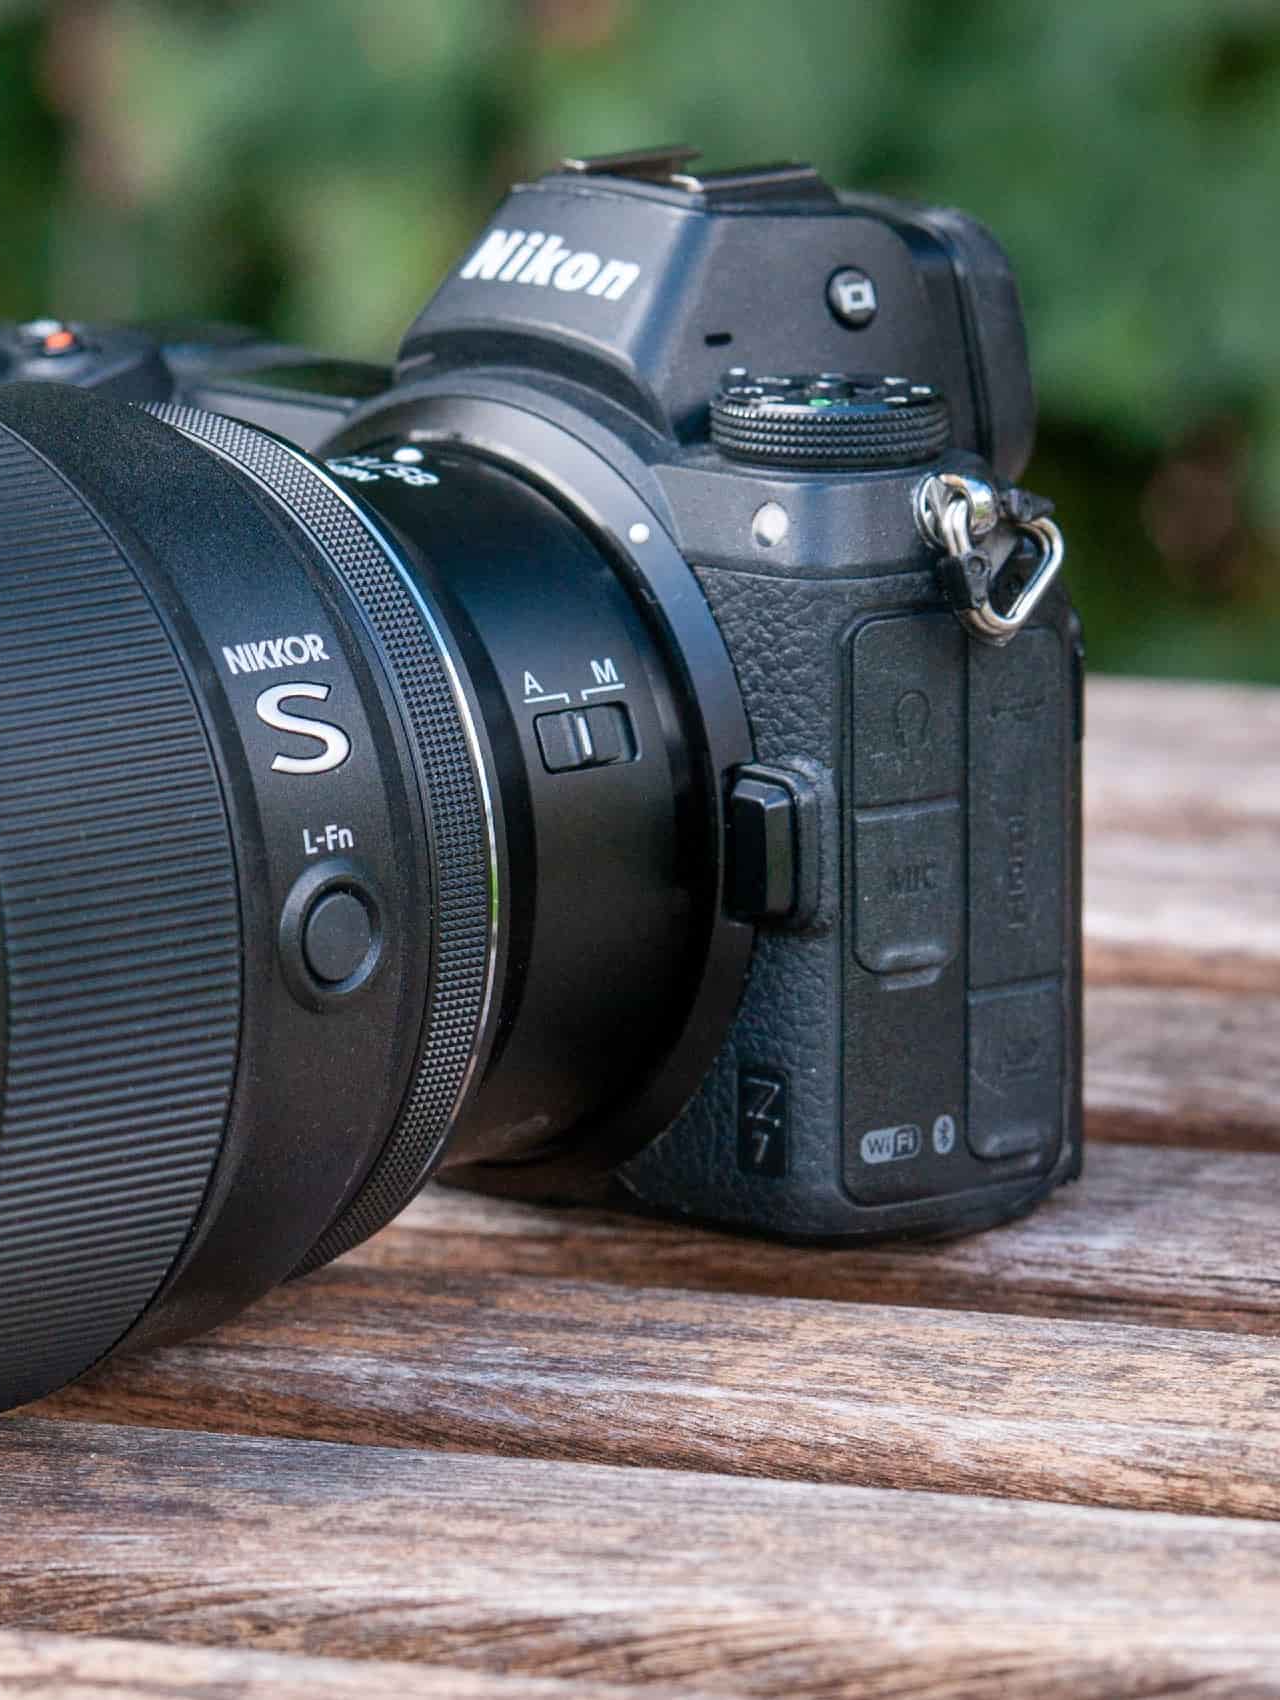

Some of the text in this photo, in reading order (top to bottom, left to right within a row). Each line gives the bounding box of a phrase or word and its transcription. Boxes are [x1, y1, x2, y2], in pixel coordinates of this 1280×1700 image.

[459, 228, 641, 301] Nikon
[221, 633, 331, 675] NIKKOR
[590, 658, 619, 684] M
[523, 670, 544, 695] A
[256, 680, 352, 775] S
[302, 824, 354, 855] L-Fn
